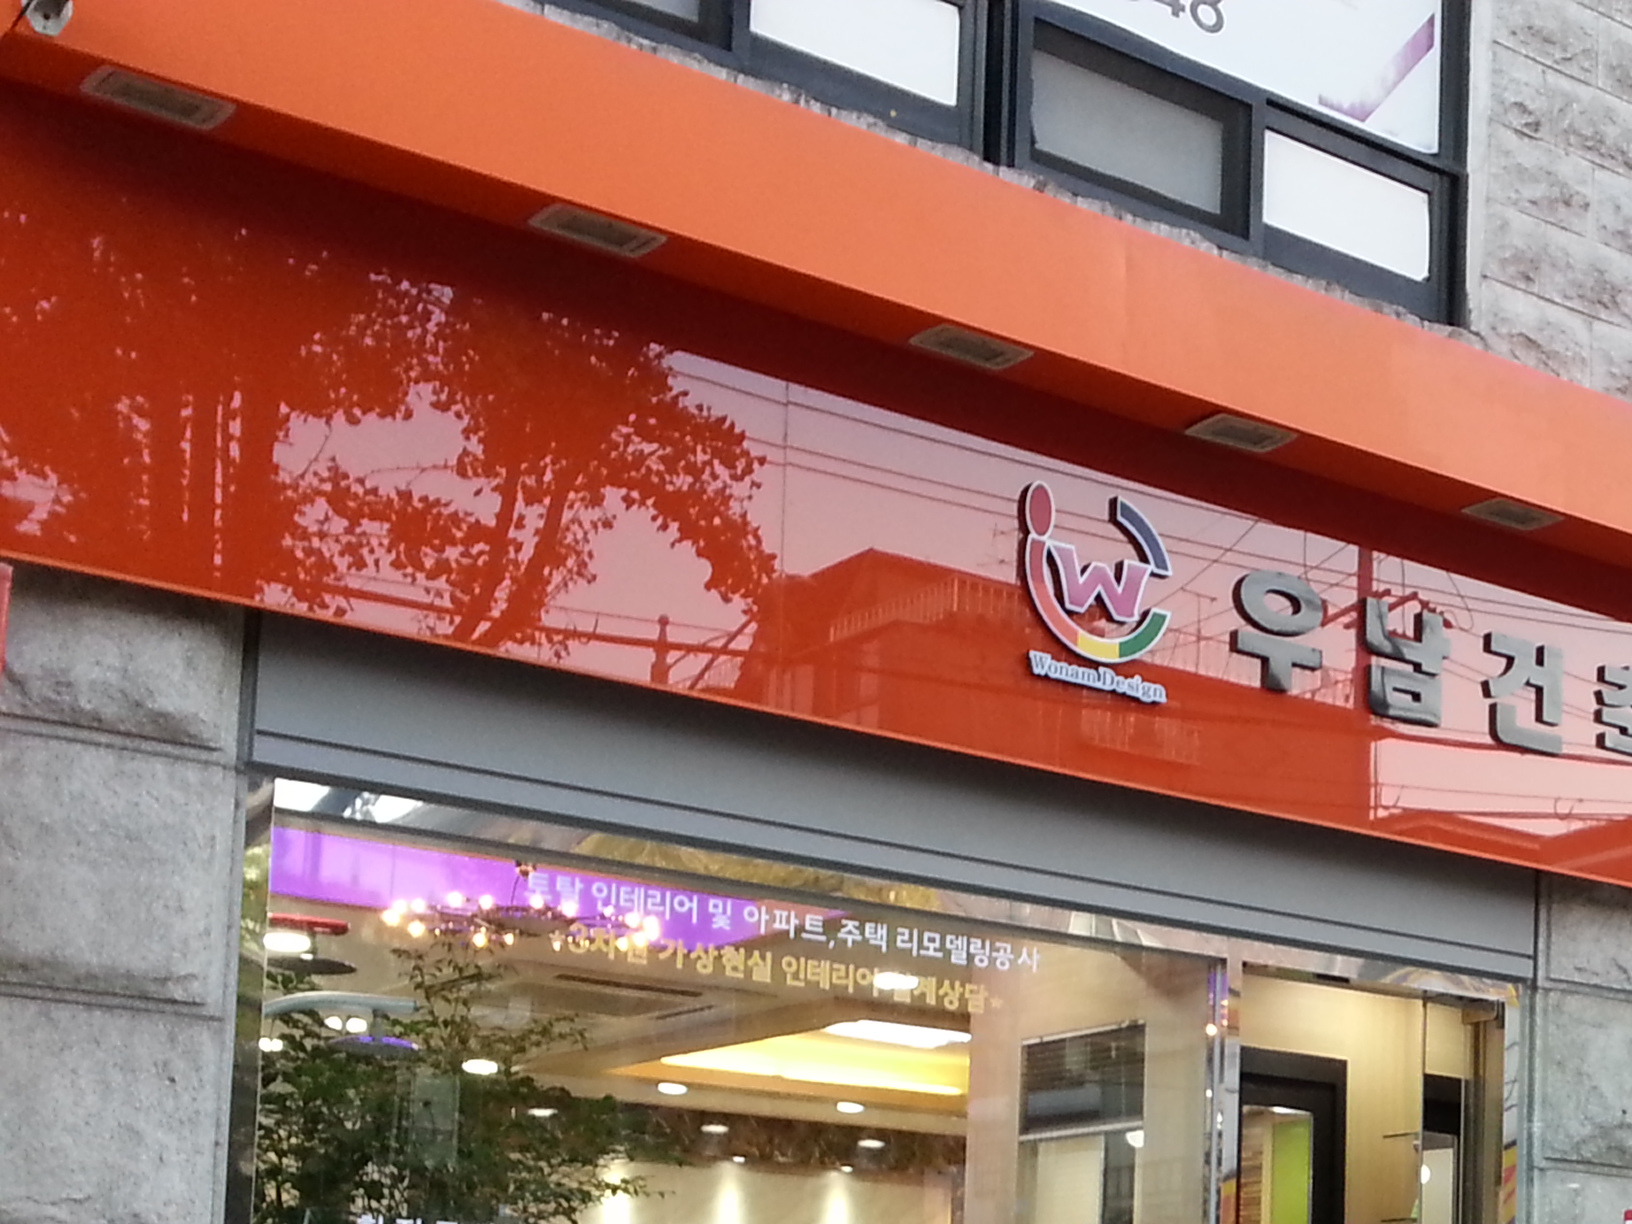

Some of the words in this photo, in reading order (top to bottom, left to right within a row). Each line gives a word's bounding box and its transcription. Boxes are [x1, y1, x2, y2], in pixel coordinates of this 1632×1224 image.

[1028, 648, 1101, 688] Wonam
[1099, 663, 1168, 705] Design
[591, 878, 701, 925] 인테리어
[708, 899, 734, 930] 및
[895, 925, 1041, 974] 리모델링공사
